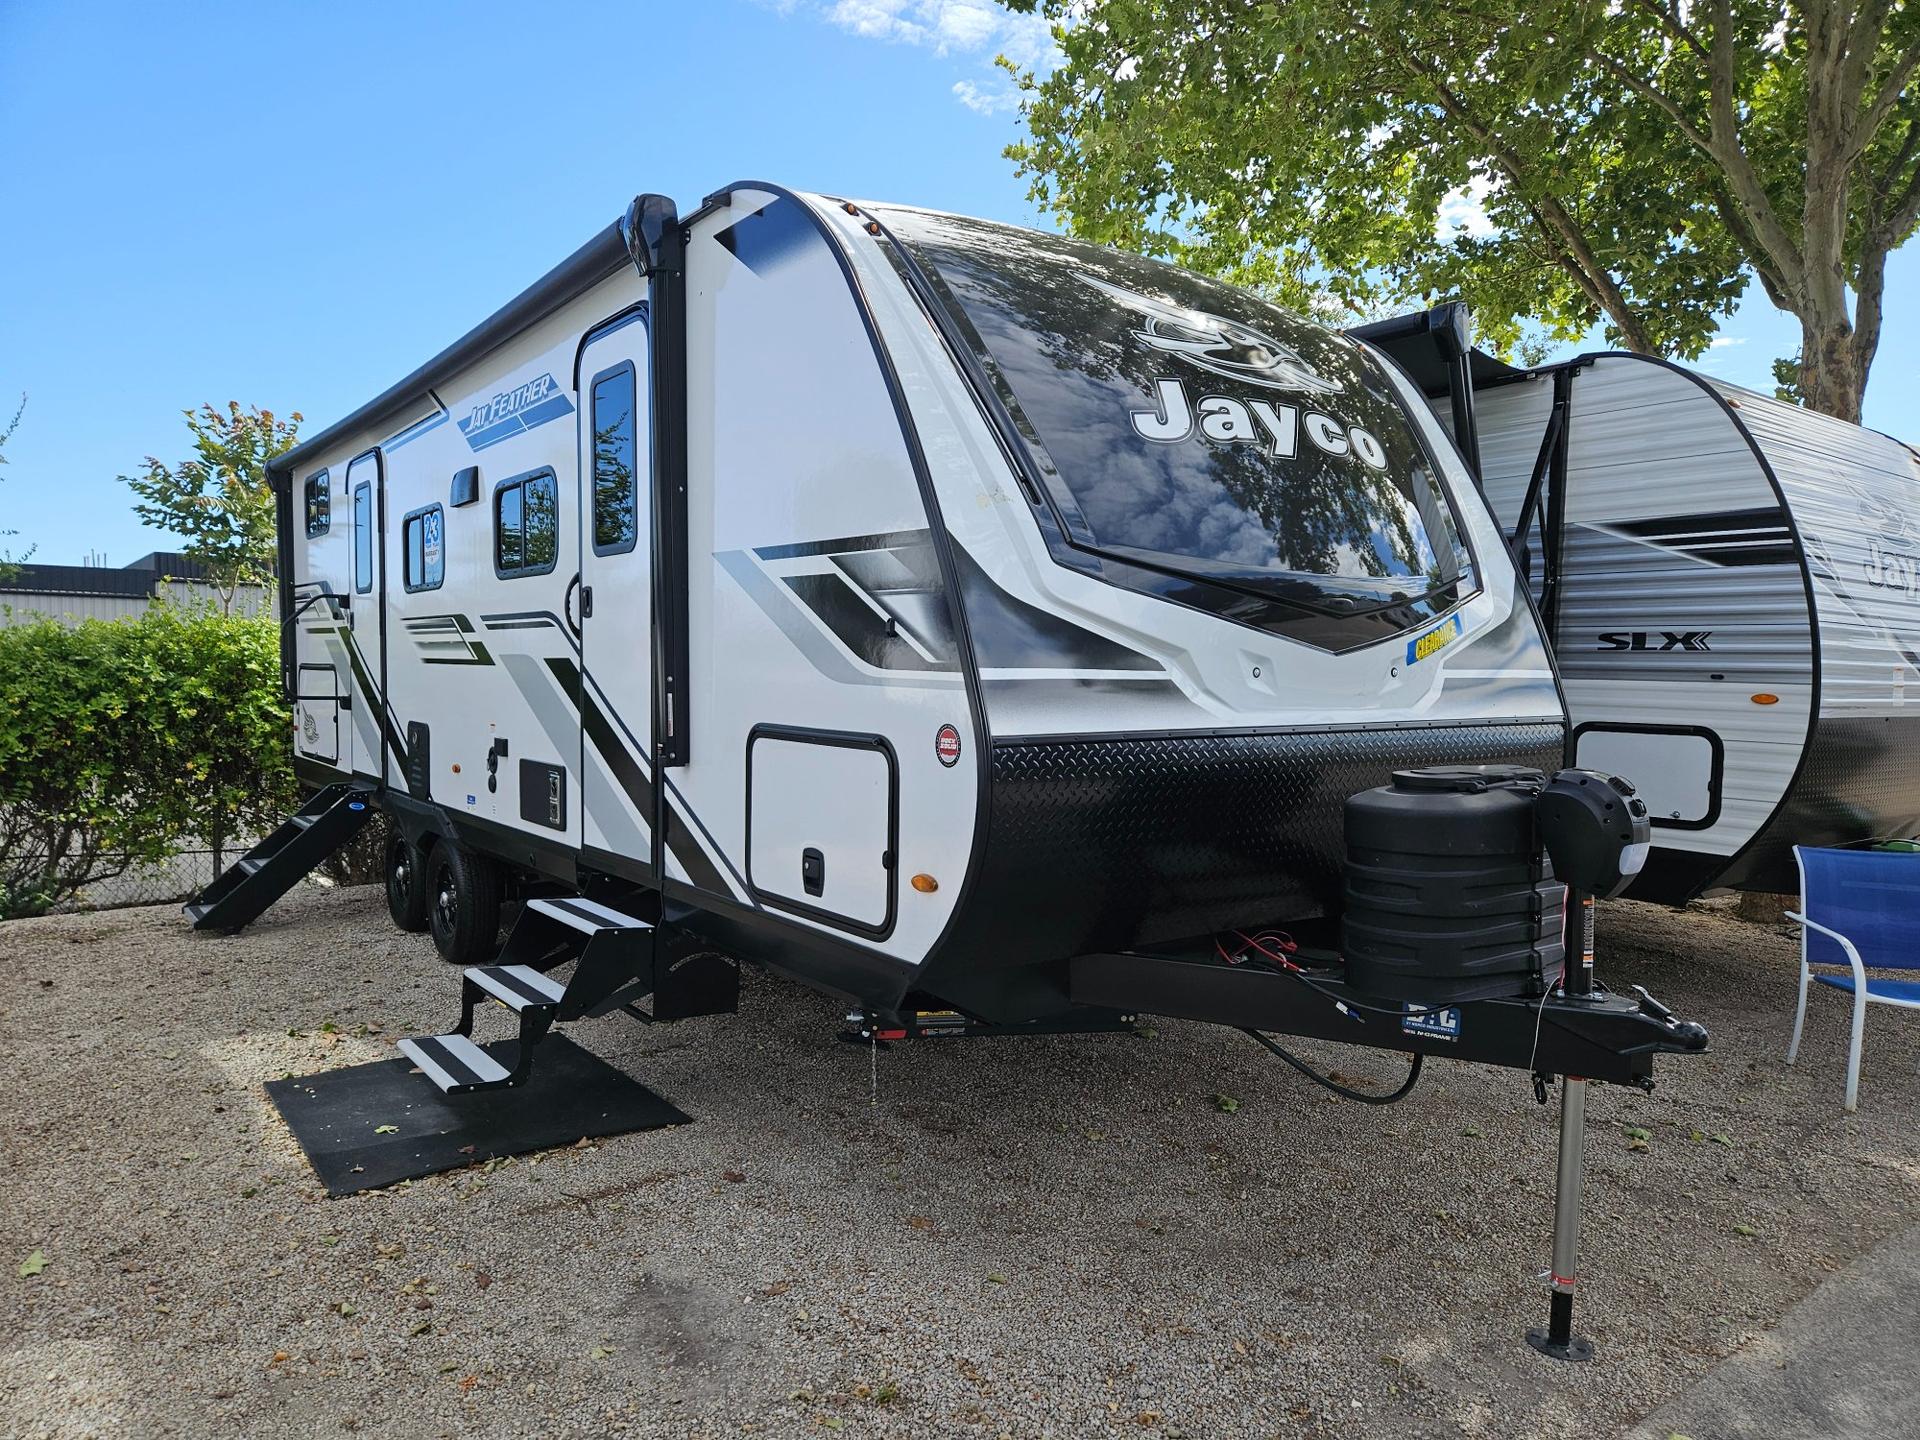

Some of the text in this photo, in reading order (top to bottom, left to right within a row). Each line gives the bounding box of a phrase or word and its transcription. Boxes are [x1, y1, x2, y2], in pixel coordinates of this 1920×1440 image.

[465, 375, 551, 432] JAY FEATHER
[1130, 377, 1389, 471] Jayco
[1597, 632, 1712, 651] SLX
